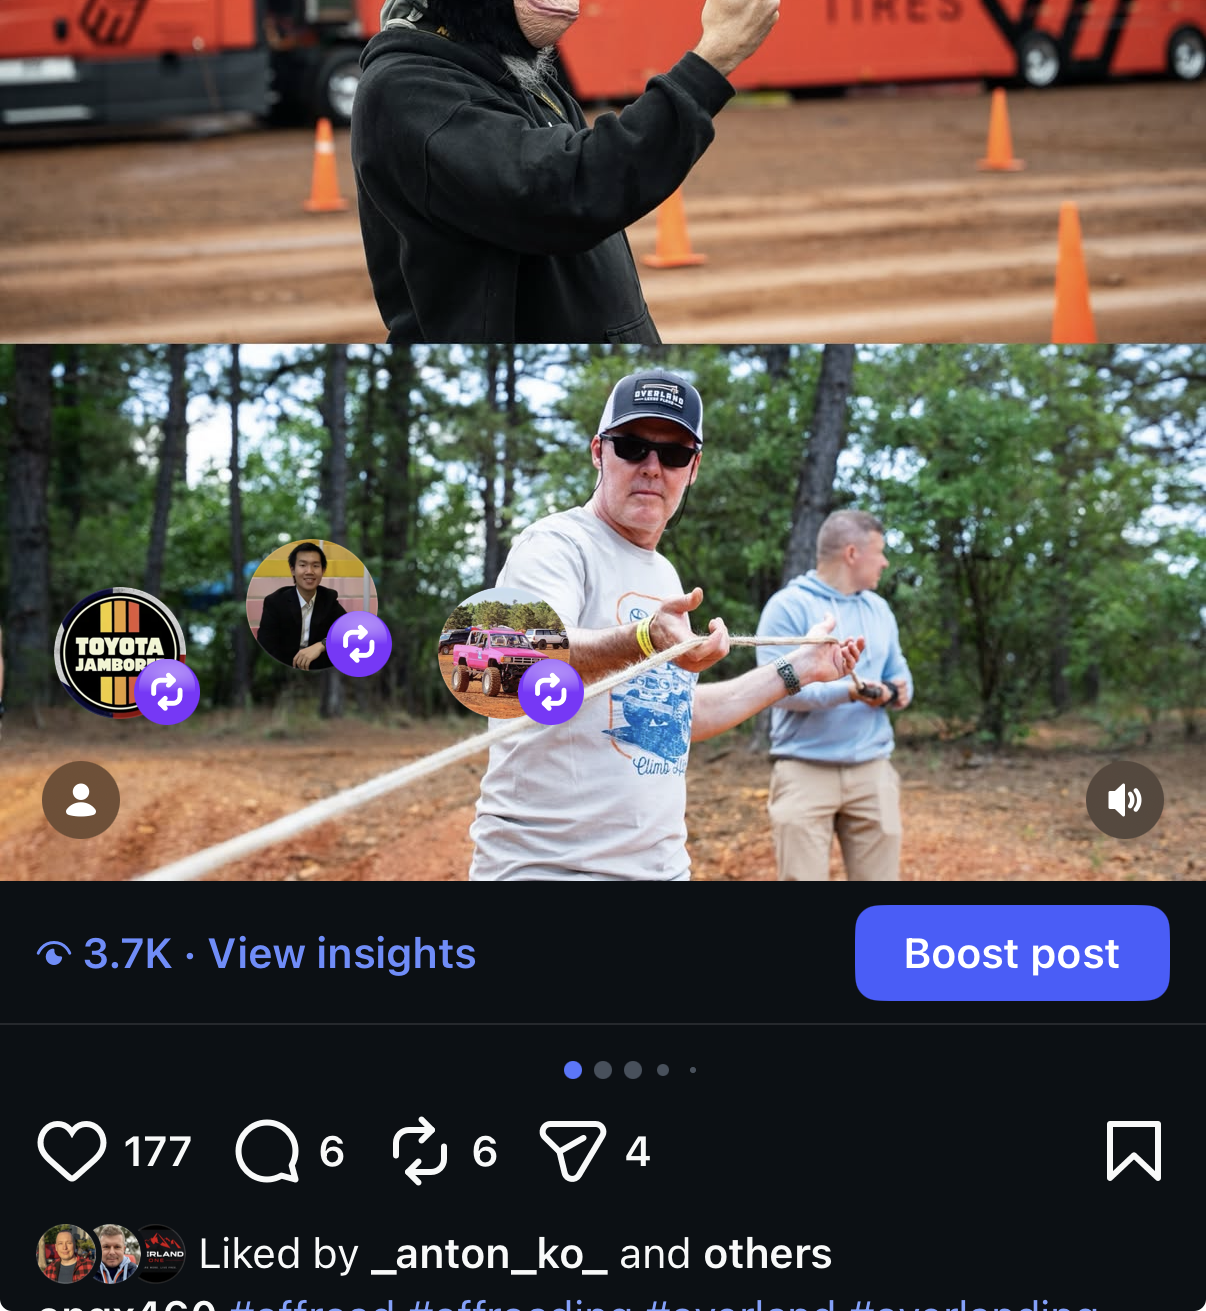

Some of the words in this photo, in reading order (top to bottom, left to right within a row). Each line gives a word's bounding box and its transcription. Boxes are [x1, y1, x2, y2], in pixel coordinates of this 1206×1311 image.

[634, 390, 684, 405] OVERLAND
[75, 637, 164, 655] TOYOTA
[75, 658, 164, 672] JAMBOR
[632, 756, 670, 776] Climb
[85, 937, 172, 970] 3.7K
[208, 936, 305, 970] View
[319, 936, 475, 977] insights
[906, 938, 1018, 970] Boost
[1033, 939, 1119, 977] post
[125, 1136, 191, 1167] 177
[320, 1135, 344, 1168] 6
[473, 1135, 497, 1168] 6
[626, 1135, 650, 1167] 4
[202, 1237, 299, 1270] Liked
[315, 1237, 358, 1277] by
[371, 1237, 608, 1276] _anton_ko_
[621, 1237, 689, 1270] and
[705, 1237, 831, 1270] others
